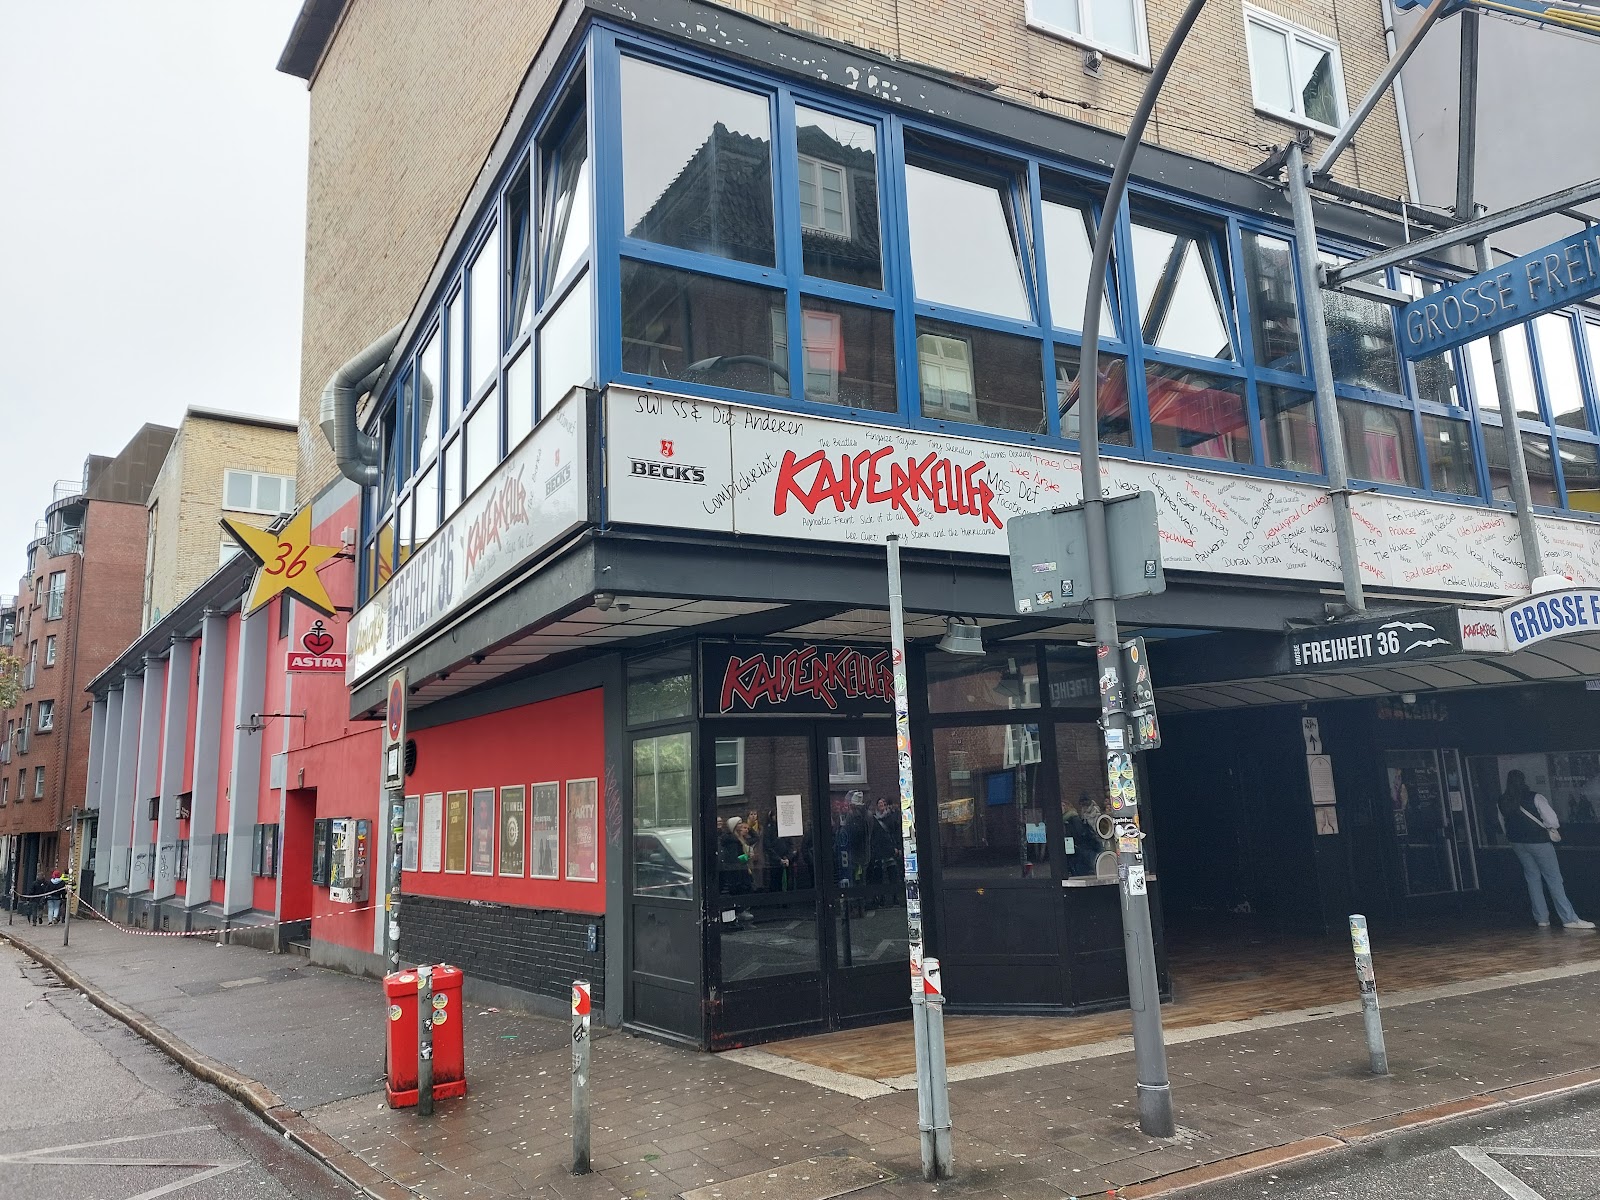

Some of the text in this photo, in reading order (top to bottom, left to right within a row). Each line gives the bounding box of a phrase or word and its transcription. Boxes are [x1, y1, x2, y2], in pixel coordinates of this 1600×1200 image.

[1407, 271, 1518, 344] GROSSE
[630, 460, 706, 483] BECK'S
[1033, 455, 1061, 470] Tracy
[773, 449, 1004, 530] KAISERKELLER
[985, 469, 1041, 504] Mos Def
[1386, 512, 1404, 522] Foo
[264, 542, 311, 579] 36
[392, 544, 436, 648] FREIHEIT
[438, 524, 455, 612] 36
[1510, 595, 1588, 644] GROSSE
[291, 656, 344, 669] ASTRA
[1301, 630, 1400, 665] FREIHEIT 36
